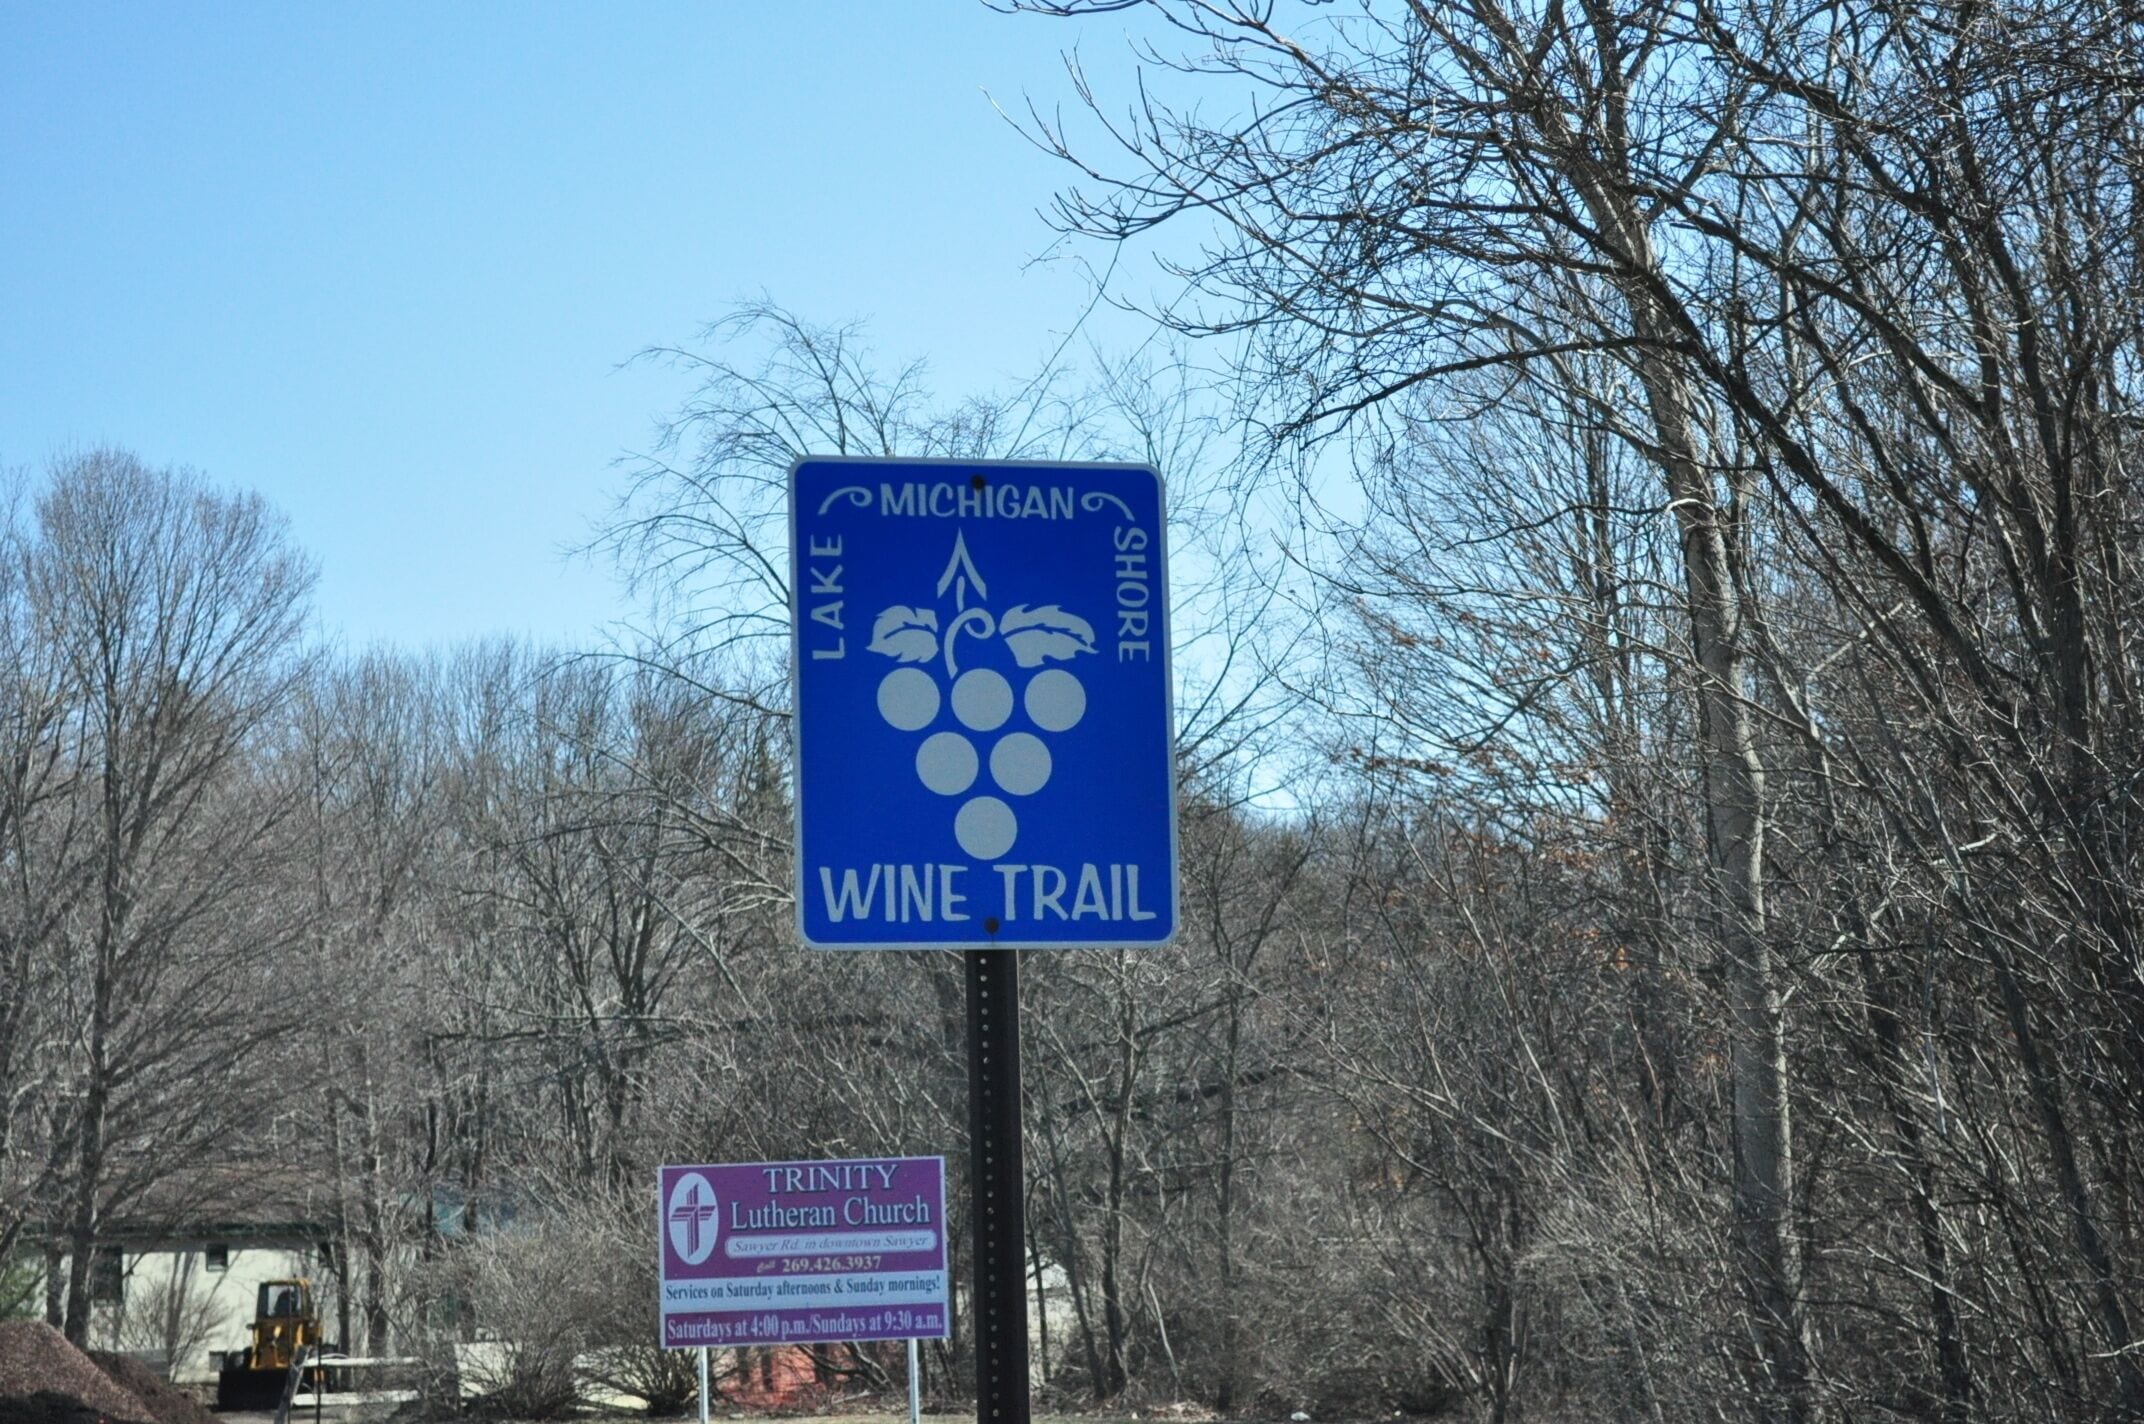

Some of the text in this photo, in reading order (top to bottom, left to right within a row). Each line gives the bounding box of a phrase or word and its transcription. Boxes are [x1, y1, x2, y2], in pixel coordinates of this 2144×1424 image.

[880, 483, 1074, 519] MICHIGAN
[810, 534, 845, 660] LAKE
[1113, 526, 1150, 663] SHORE
[819, 862, 1157, 923] WINE TRAIL
[763, 1164, 898, 1194] TRINITY
[731, 1195, 931, 1230] Lutheran Church
[734, 1240, 779, 1253] Sawyer
[883, 1235, 929, 1248] Sawyer
[782, 1255, 882, 1273] 269.426.3937
[666, 1274, 941, 1300] Services on Saturday afternoons & Sunday mornings!
[667, 1318, 732, 1342] Saturdays
[734, 1320, 748, 1337] at
[750, 1315, 779, 1337] 4:00
[868, 1313, 882, 1331] at
[884, 1310, 913, 1331] 9:30
[915, 1313, 943, 1330] a.m.
